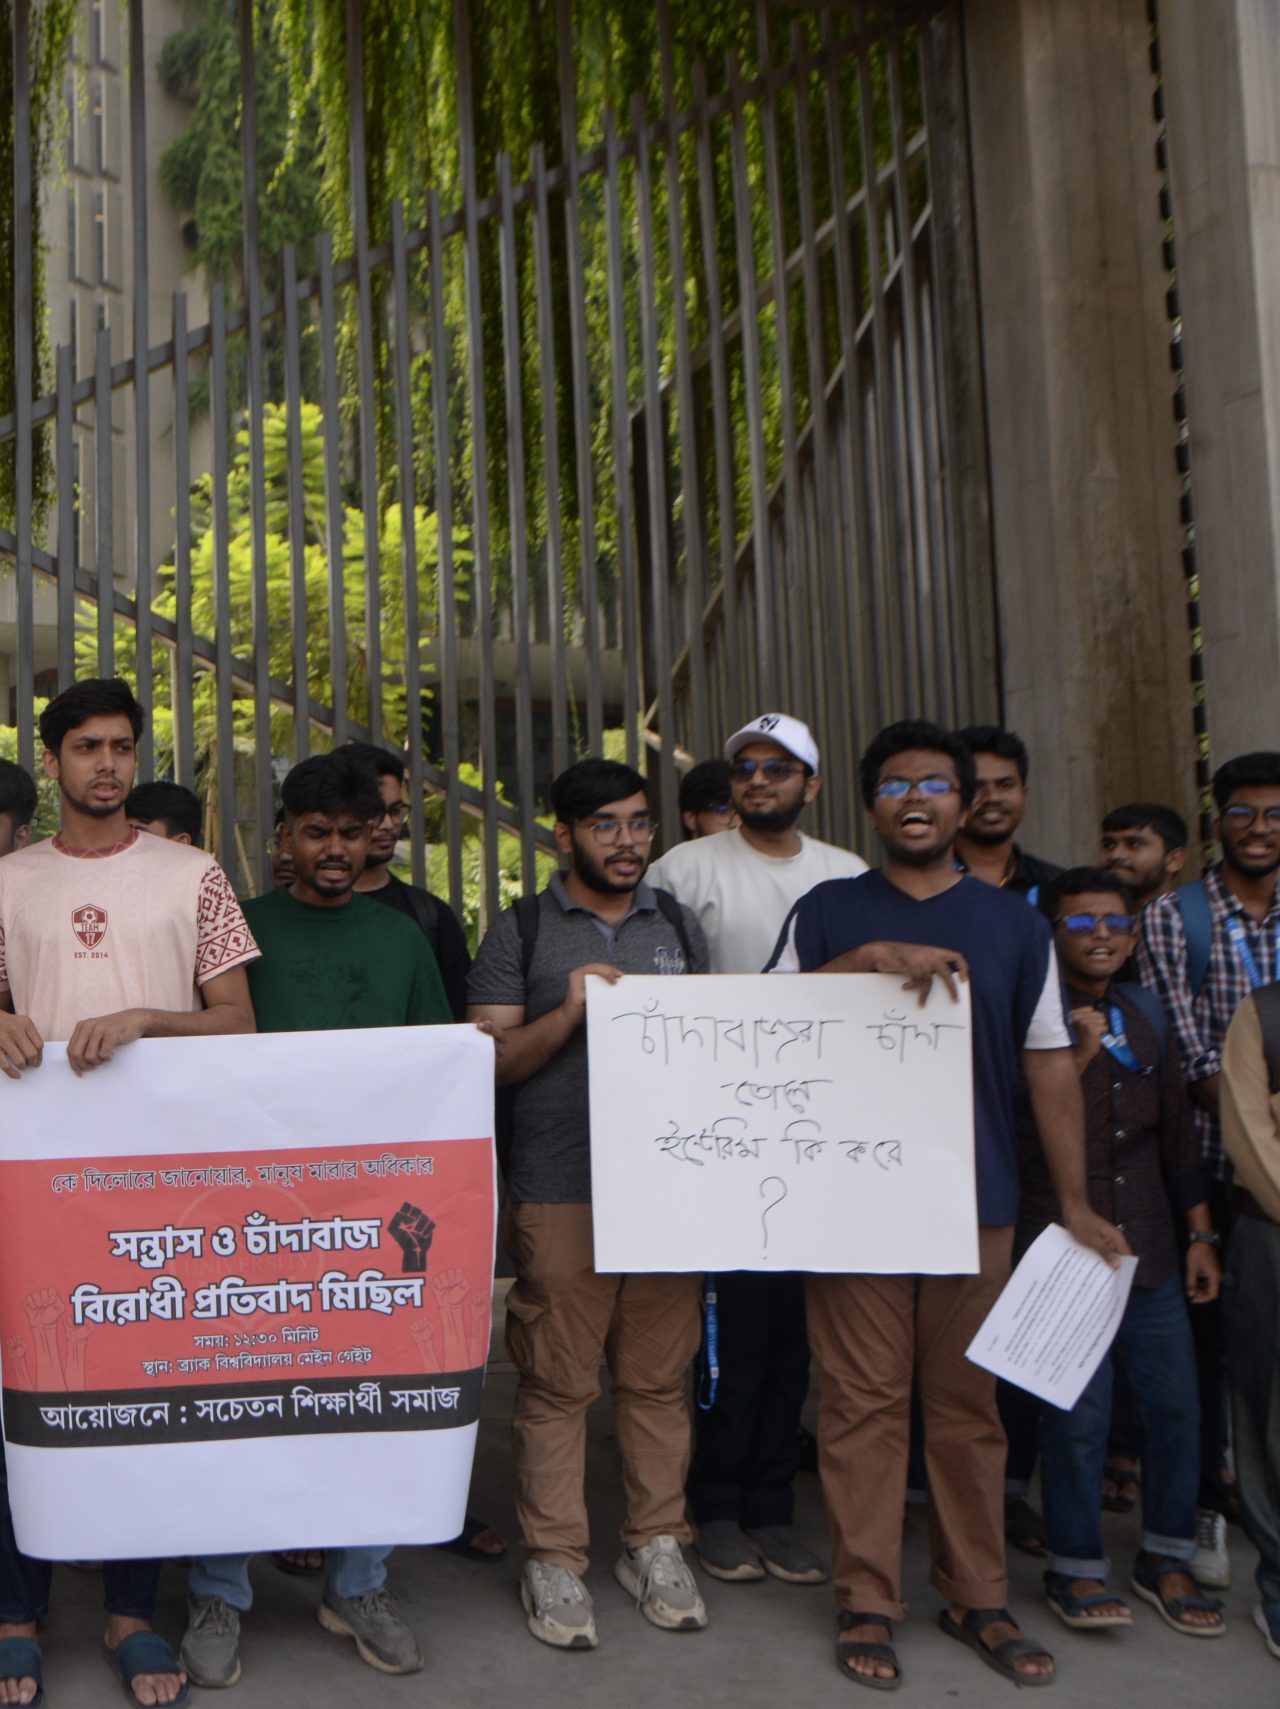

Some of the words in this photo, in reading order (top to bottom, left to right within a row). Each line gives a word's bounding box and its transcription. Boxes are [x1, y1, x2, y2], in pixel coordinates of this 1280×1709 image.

[81, 923, 99, 932] TEAM
[85, 932, 96, 945] 17
[74, 951, 89, 959] EST.
[91, 951, 109, 959] 2014
[780, 1119, 827, 1165] কি
[51, 1172, 78, 1193] কে
[83, 1167, 155, 1191] দিলোরে
[160, 1164, 253, 1189] জানোয়ার,
[257, 1160, 304, 1188] মানুষ
[310, 1158, 358, 1181] মারার
[363, 1153, 434, 1177] অধিকার
[759, 1175, 788, 1259] ?
[108, 1224, 204, 1269] সন্ত্রাস
[211, 1225, 237, 1257] ও
[242, 1210, 382, 1255] চাঁদাবাজ
[184, 1256, 308, 1275] UNIVERSITY
[70, 1274, 187, 1325] বিরোধী
[191, 1275, 314, 1319] প্রতিবাদ
[318, 1269, 426, 1316] মিছিল
[234, 1332, 277, 1346] ১২:৩০
[282, 1325, 320, 1344] মিনিট
[297, 1347, 333, 1365] মেইন
[337, 1345, 373, 1363] গেইট
[40, 1401, 170, 1431] আয়োজনে
[195, 1392, 283, 1425] সচেতন
[291, 1381, 382, 1420] শিক্ষার্থী
[391, 1384, 462, 1413] সমাজ
